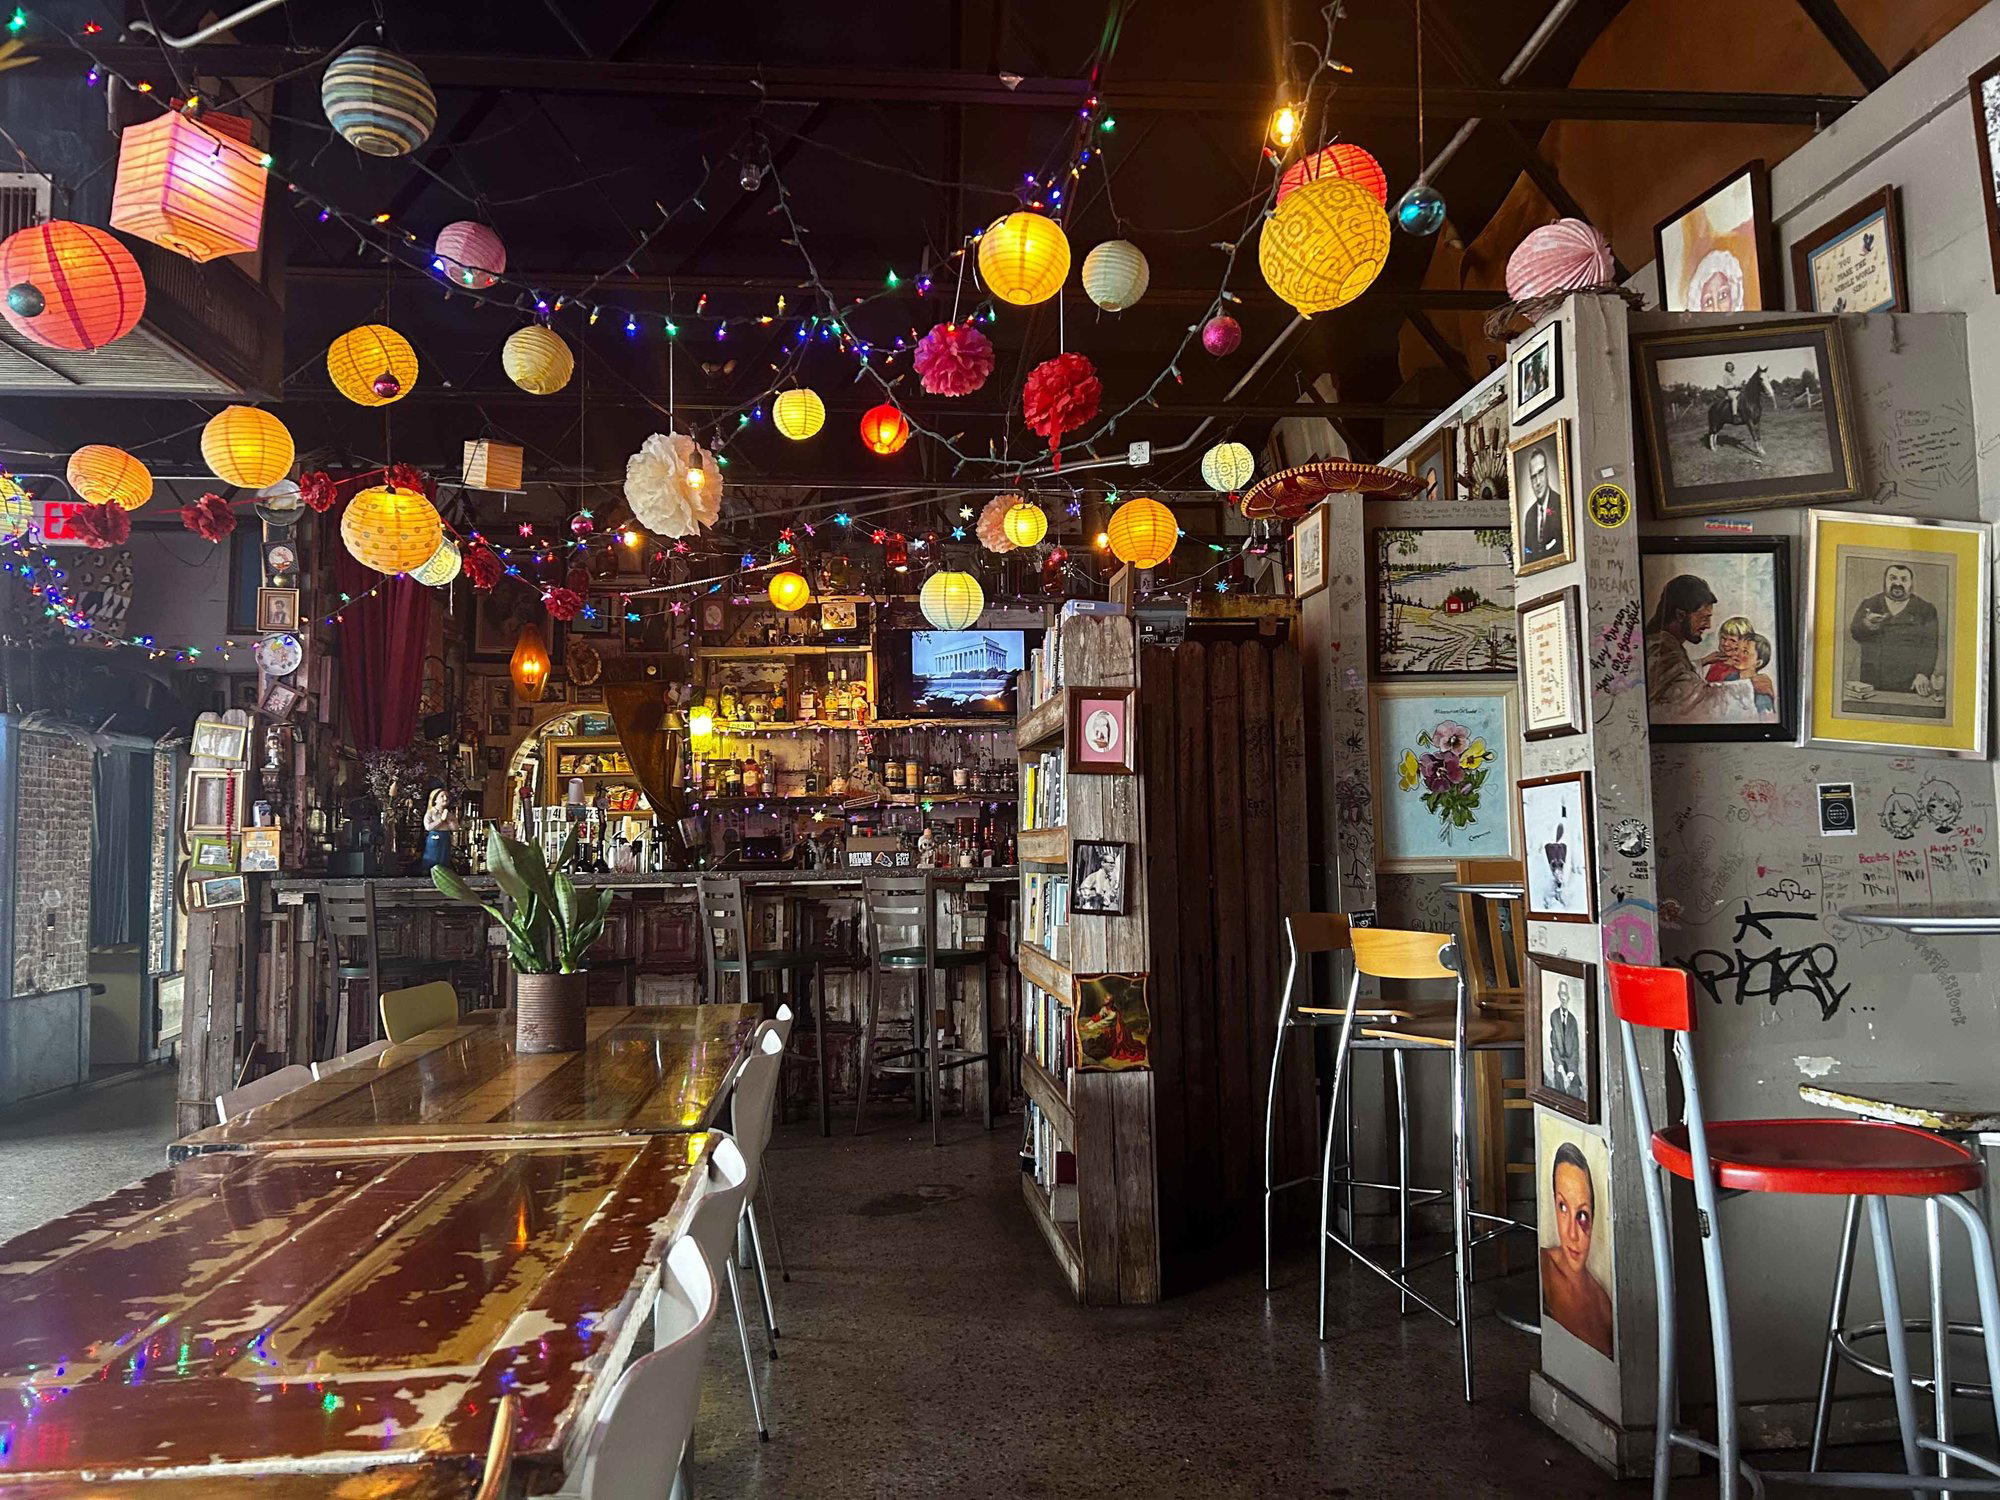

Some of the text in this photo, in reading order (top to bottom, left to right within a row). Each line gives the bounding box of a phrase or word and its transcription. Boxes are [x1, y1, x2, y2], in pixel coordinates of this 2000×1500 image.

[1855, 259, 1867, 271] THE
[1834, 265, 1876, 293] WHOLE WORLD
[1590, 577, 1635, 596] DREAMS
[749, 705, 768, 714] BAR
